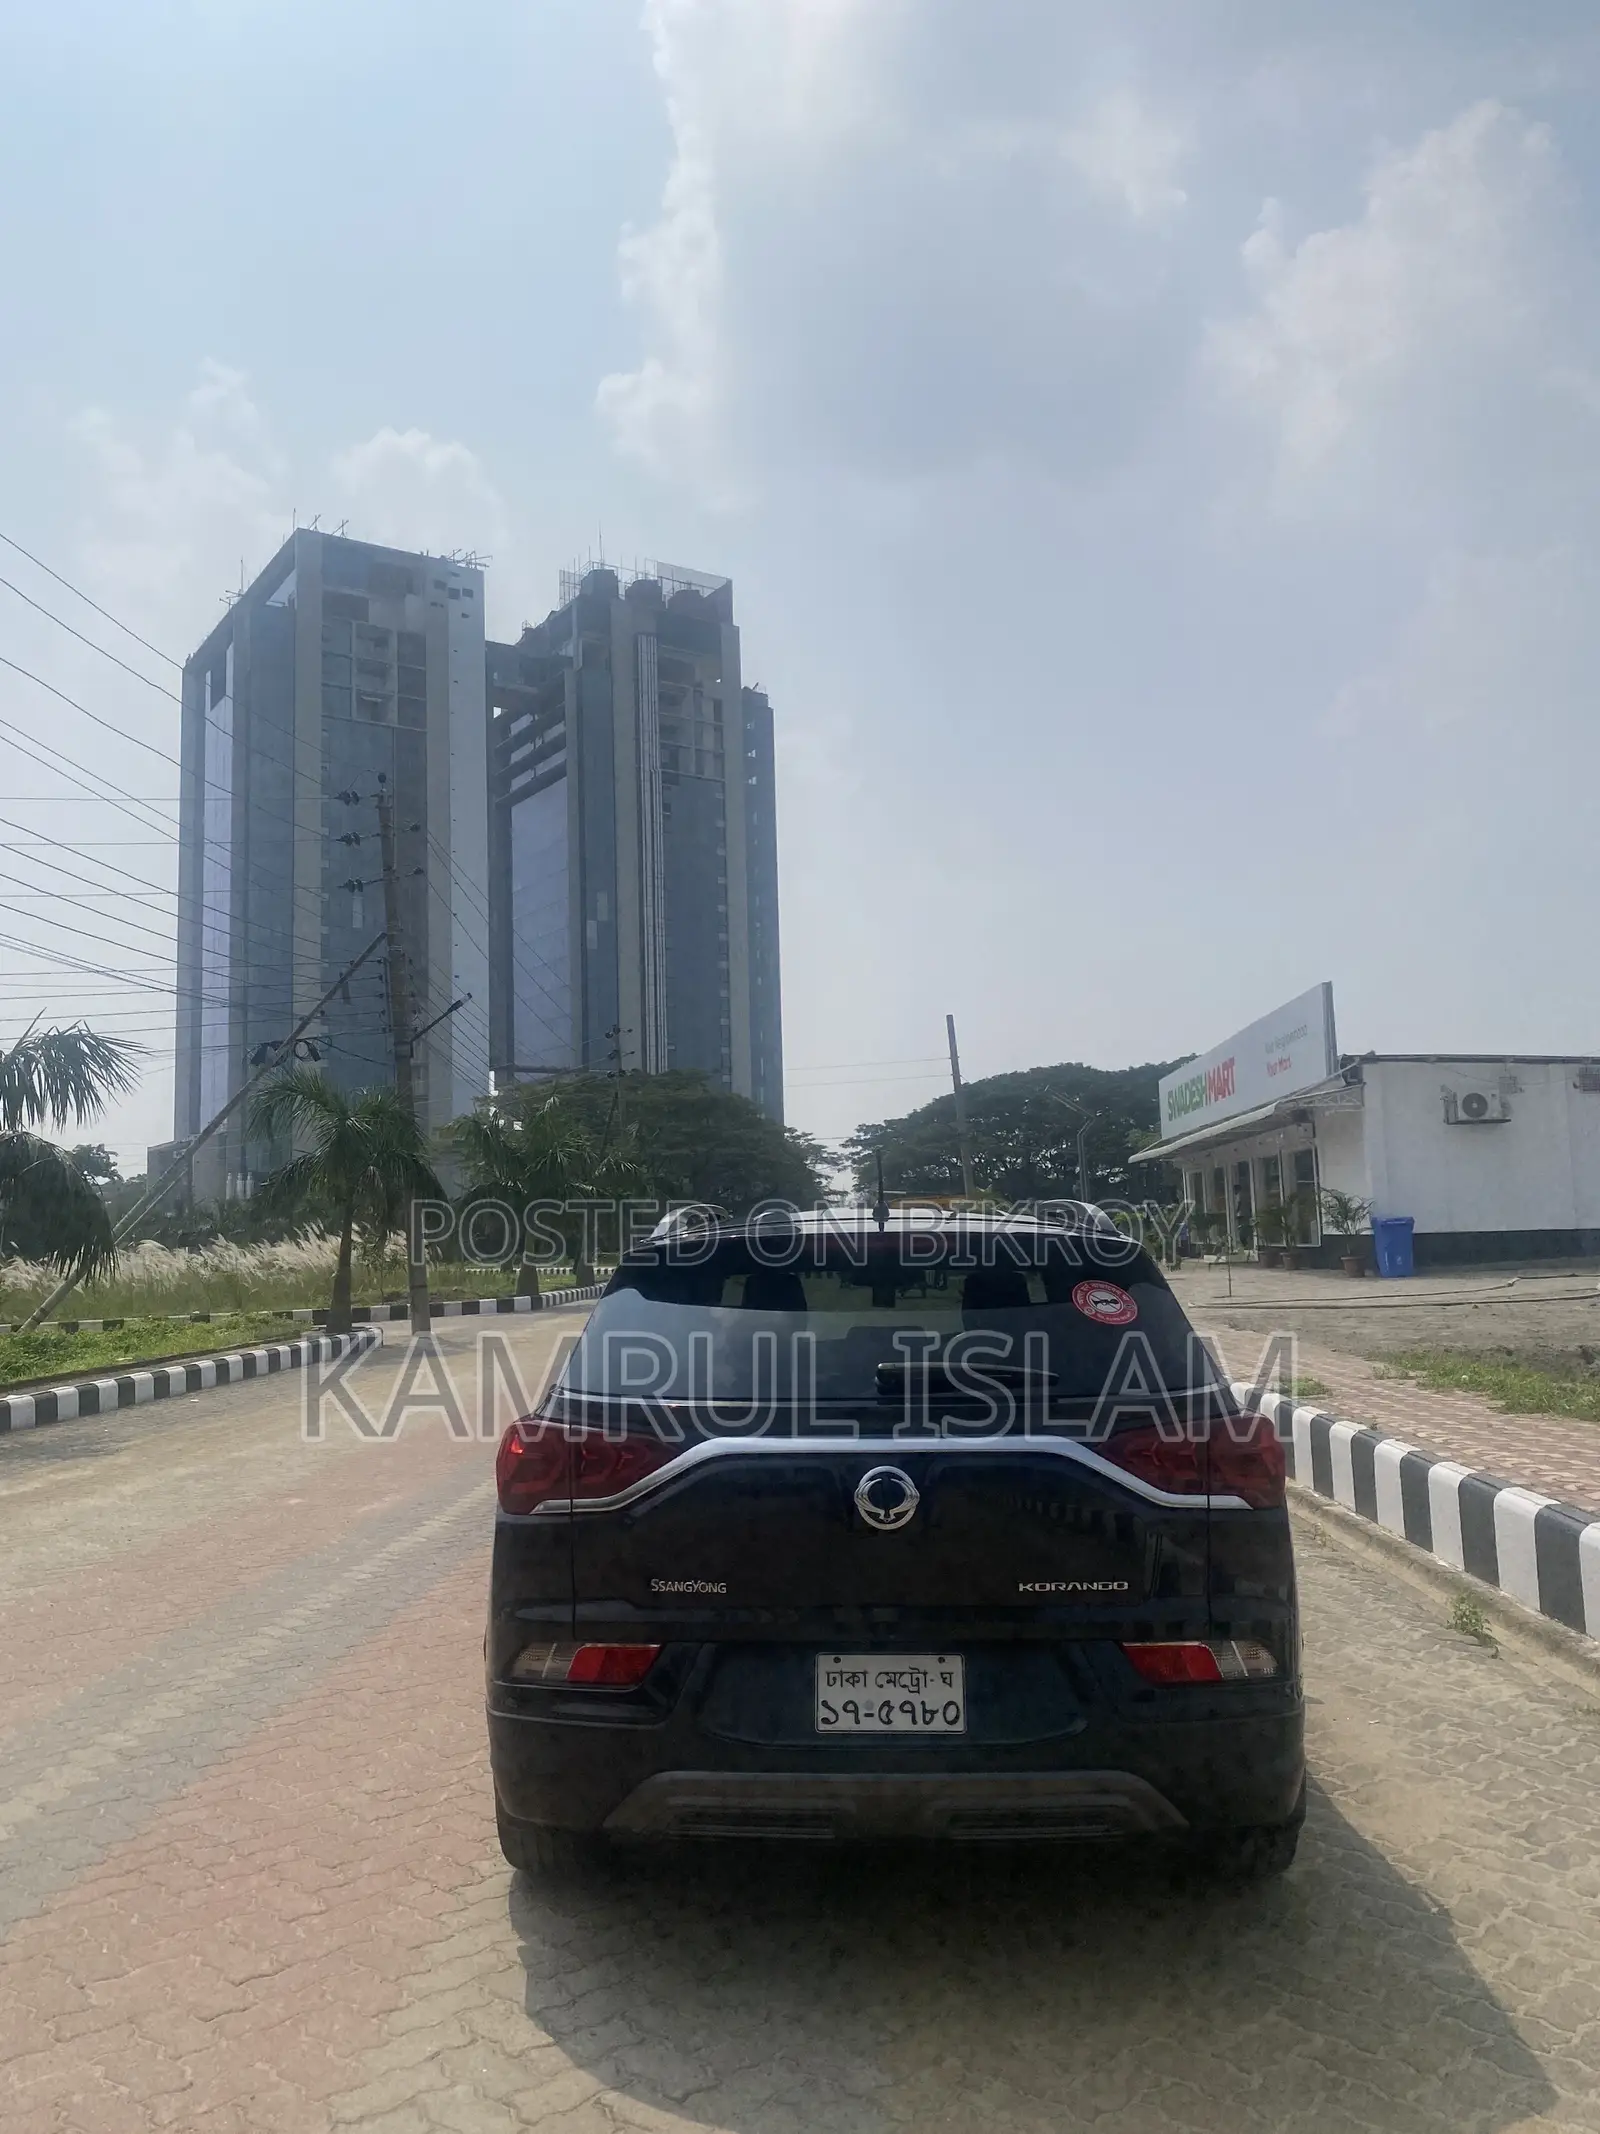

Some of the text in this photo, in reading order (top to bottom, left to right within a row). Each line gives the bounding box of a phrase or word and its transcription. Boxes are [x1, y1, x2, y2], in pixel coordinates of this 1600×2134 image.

[1018, 1581, 1129, 1592] KORANDO
[826, 1670, 868, 1688] ঢাকা
[820, 1700, 961, 1725] ১৭-৫৭৮০
